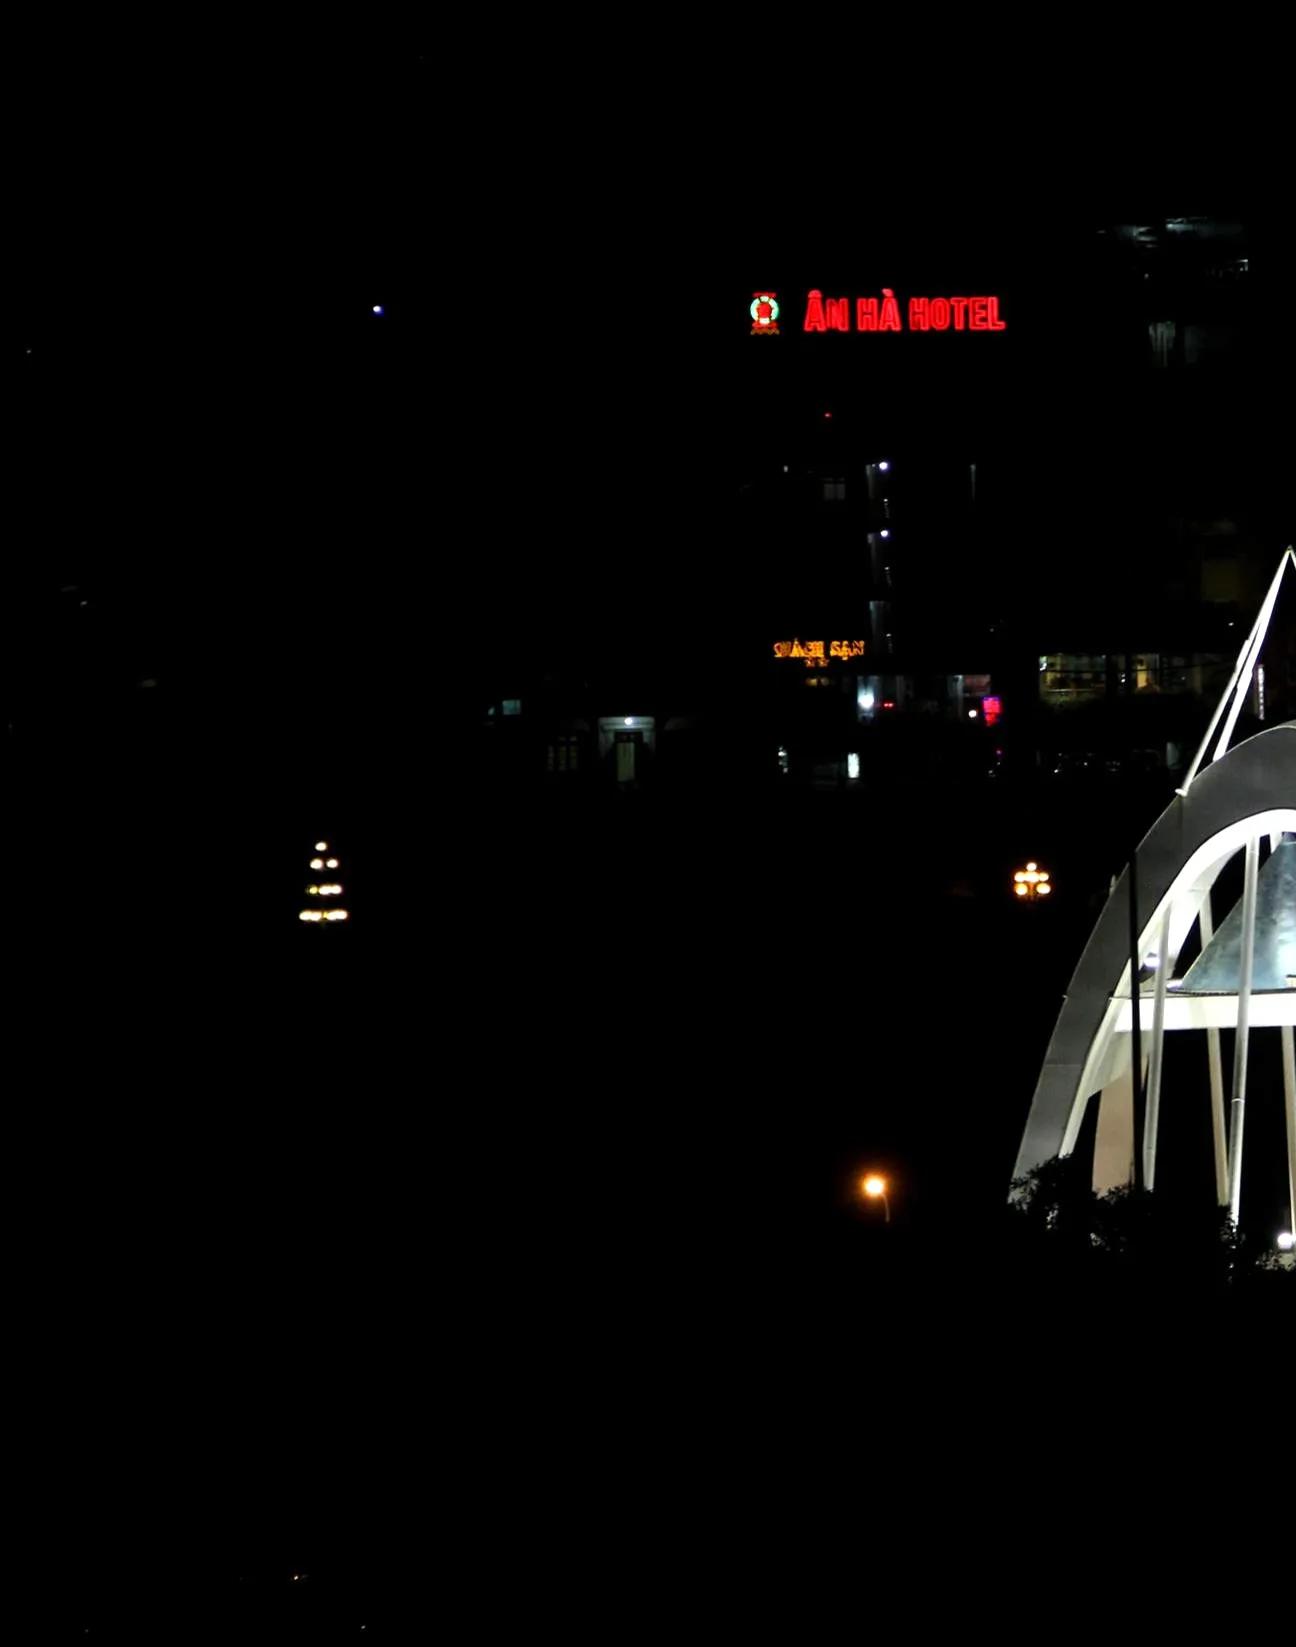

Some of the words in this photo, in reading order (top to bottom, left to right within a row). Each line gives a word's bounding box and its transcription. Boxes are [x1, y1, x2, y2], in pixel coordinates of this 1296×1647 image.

[804, 290, 849, 332] ÂN
[857, 288, 901, 332] HÀ
[909, 297, 1006, 331] HOTEL
